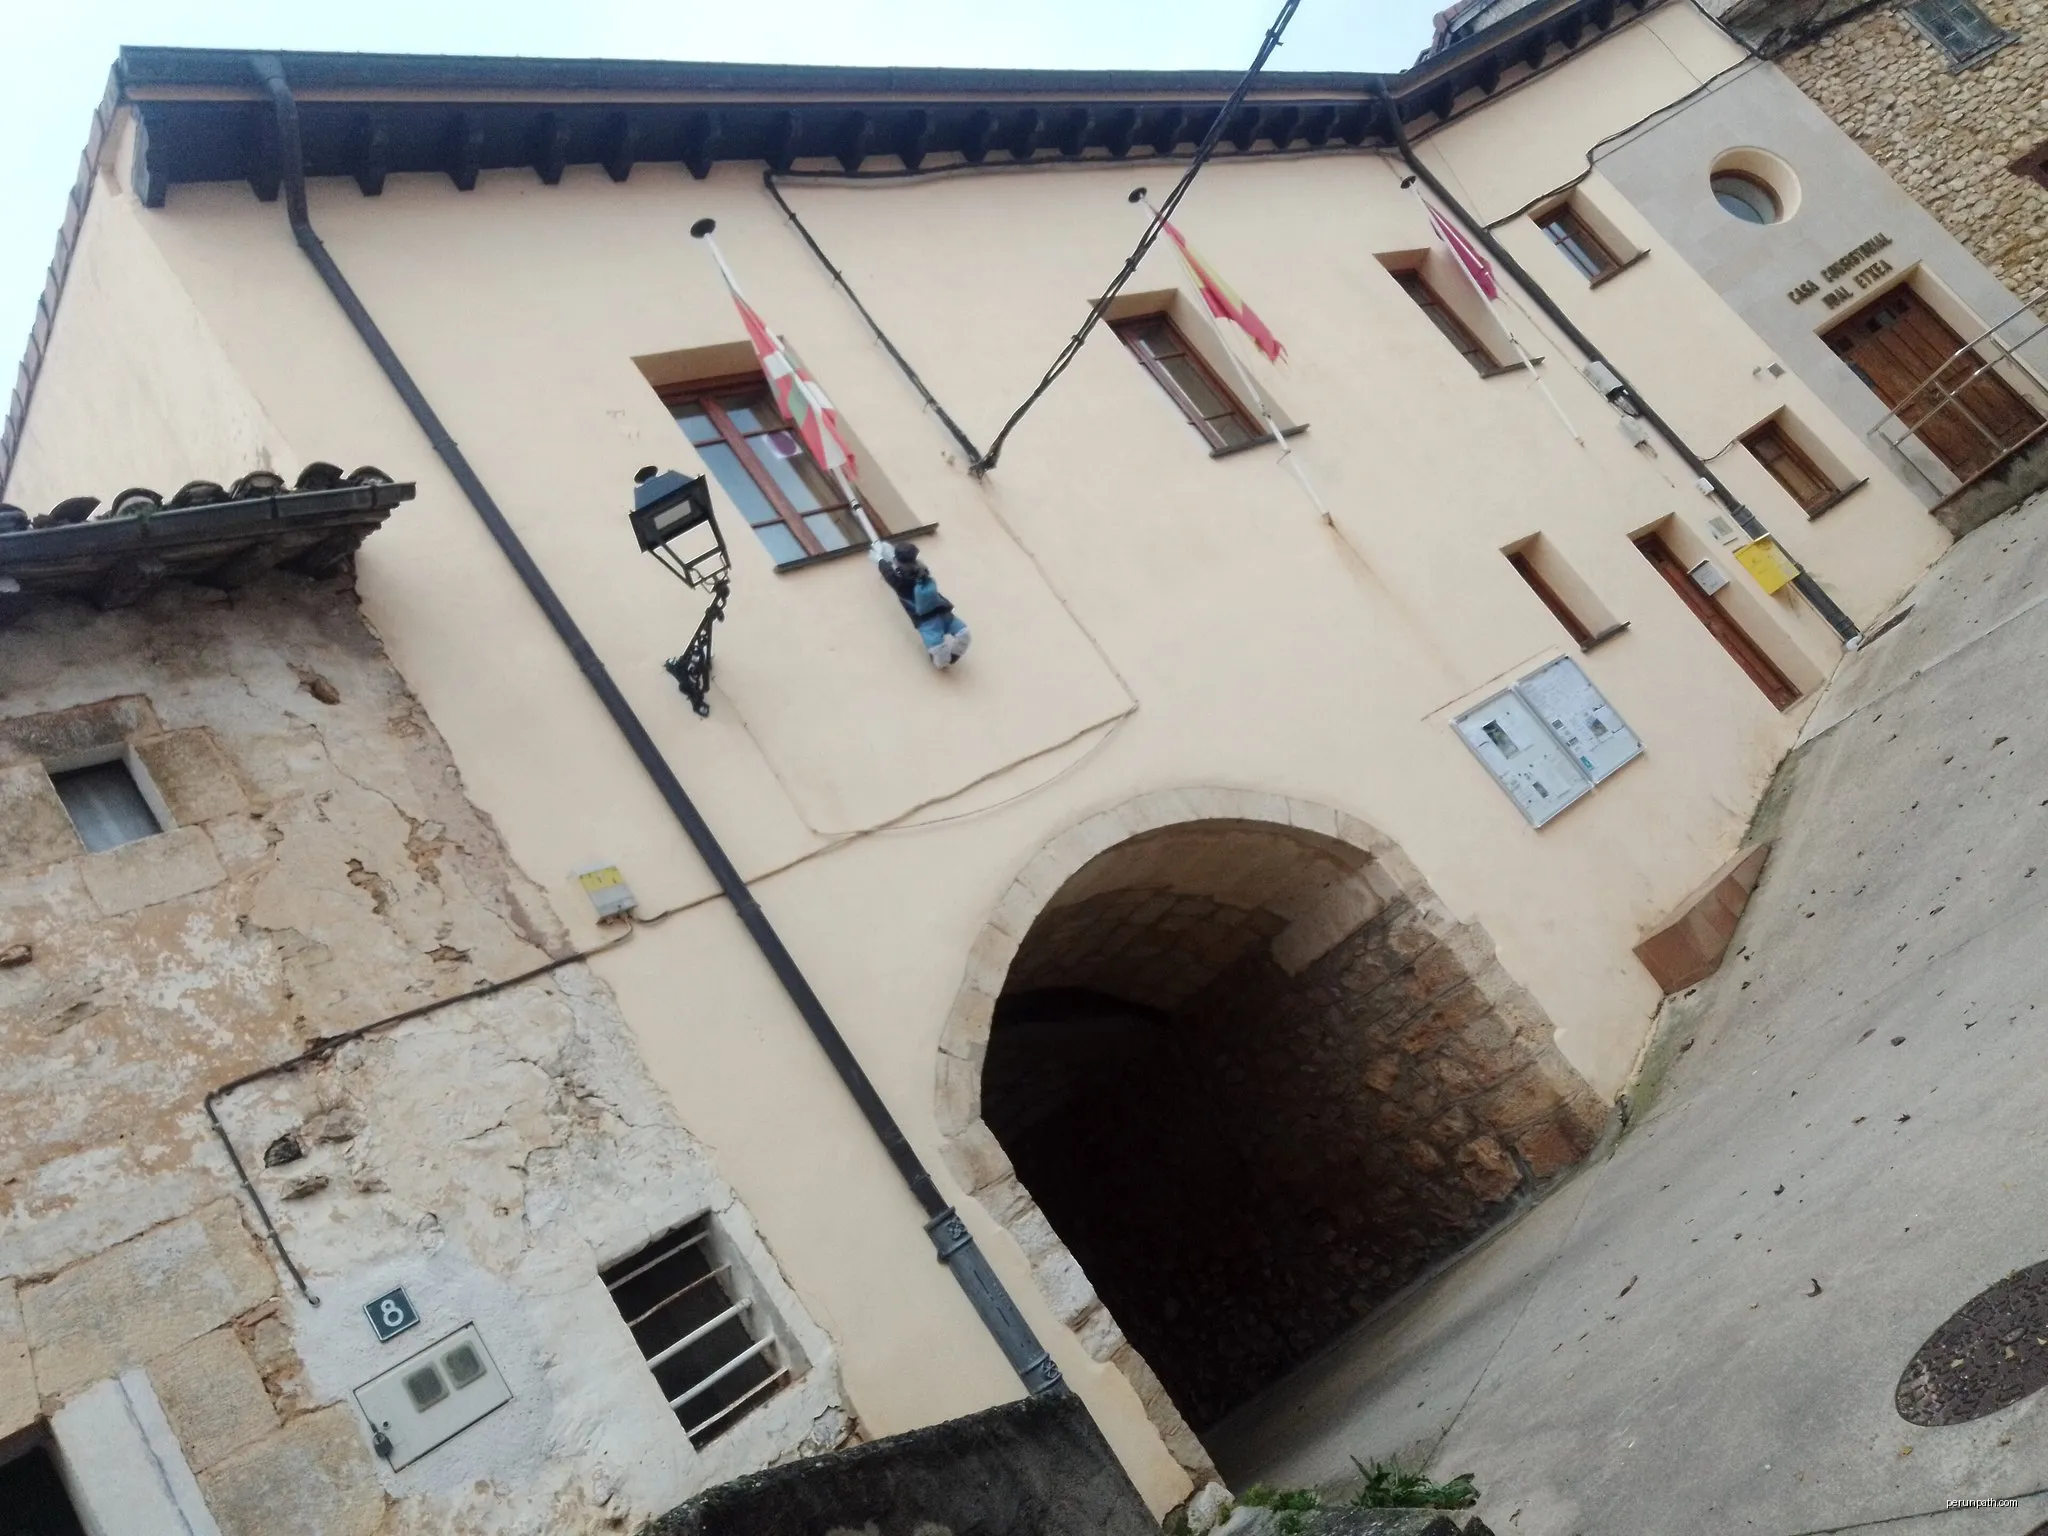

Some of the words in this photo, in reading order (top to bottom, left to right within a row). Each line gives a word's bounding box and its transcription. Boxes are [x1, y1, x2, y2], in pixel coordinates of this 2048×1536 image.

[1852, 259, 1893, 290] ETXEA
[1787, 279, 1820, 305] CASA
[380, 1299, 404, 1327] 8
